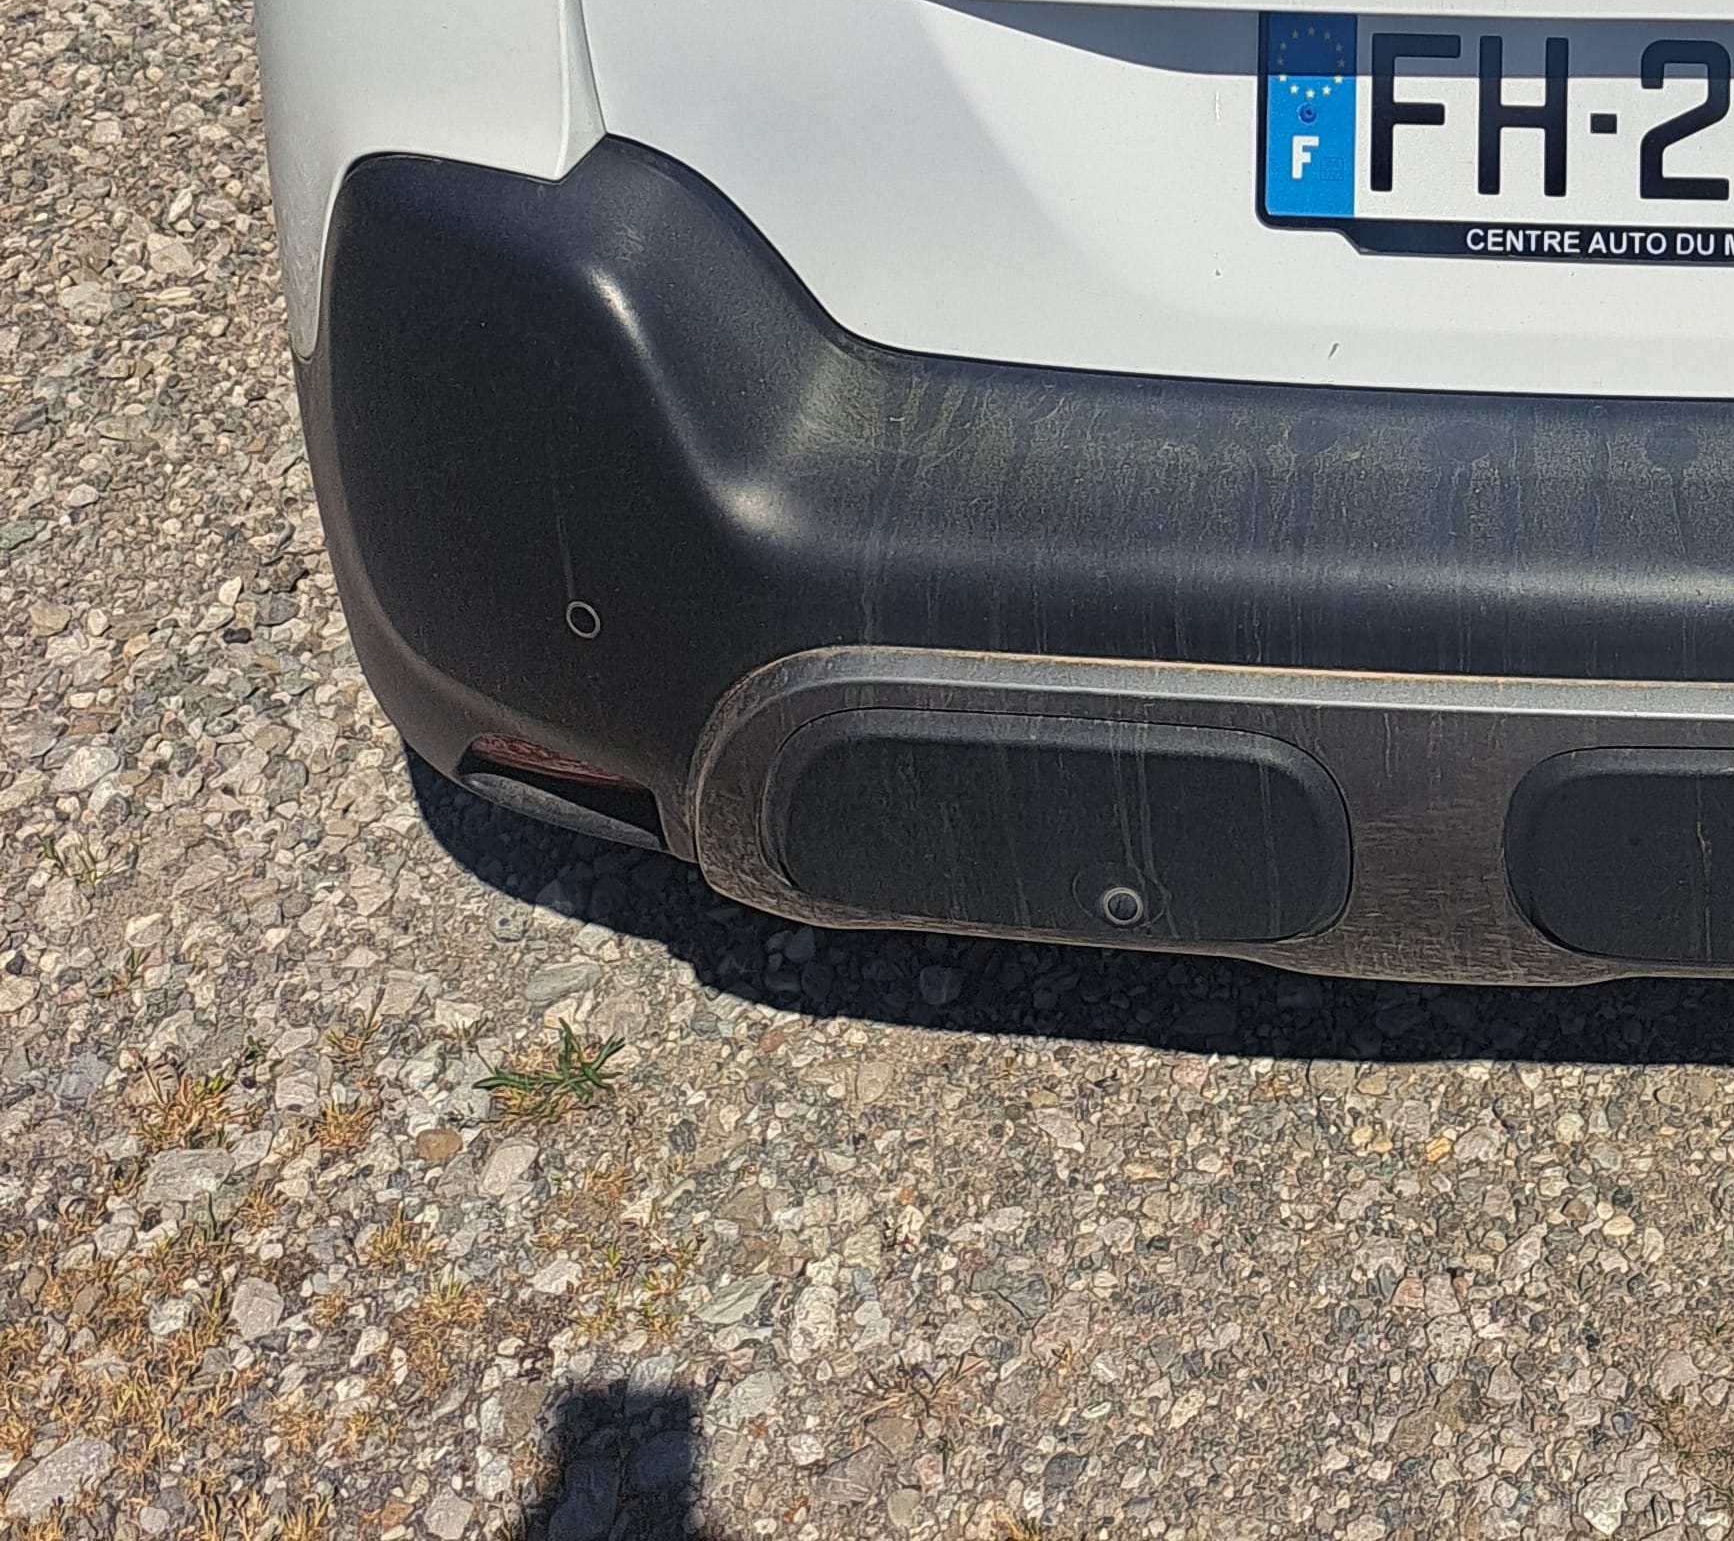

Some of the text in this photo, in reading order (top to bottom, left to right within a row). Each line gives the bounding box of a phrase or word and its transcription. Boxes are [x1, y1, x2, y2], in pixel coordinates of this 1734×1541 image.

[1292, 135, 1319, 179] F
[1466, 228, 1580, 254] CENTRE
[1588, 231, 1667, 255] AUTO
[1676, 233, 1715, 256] DU
